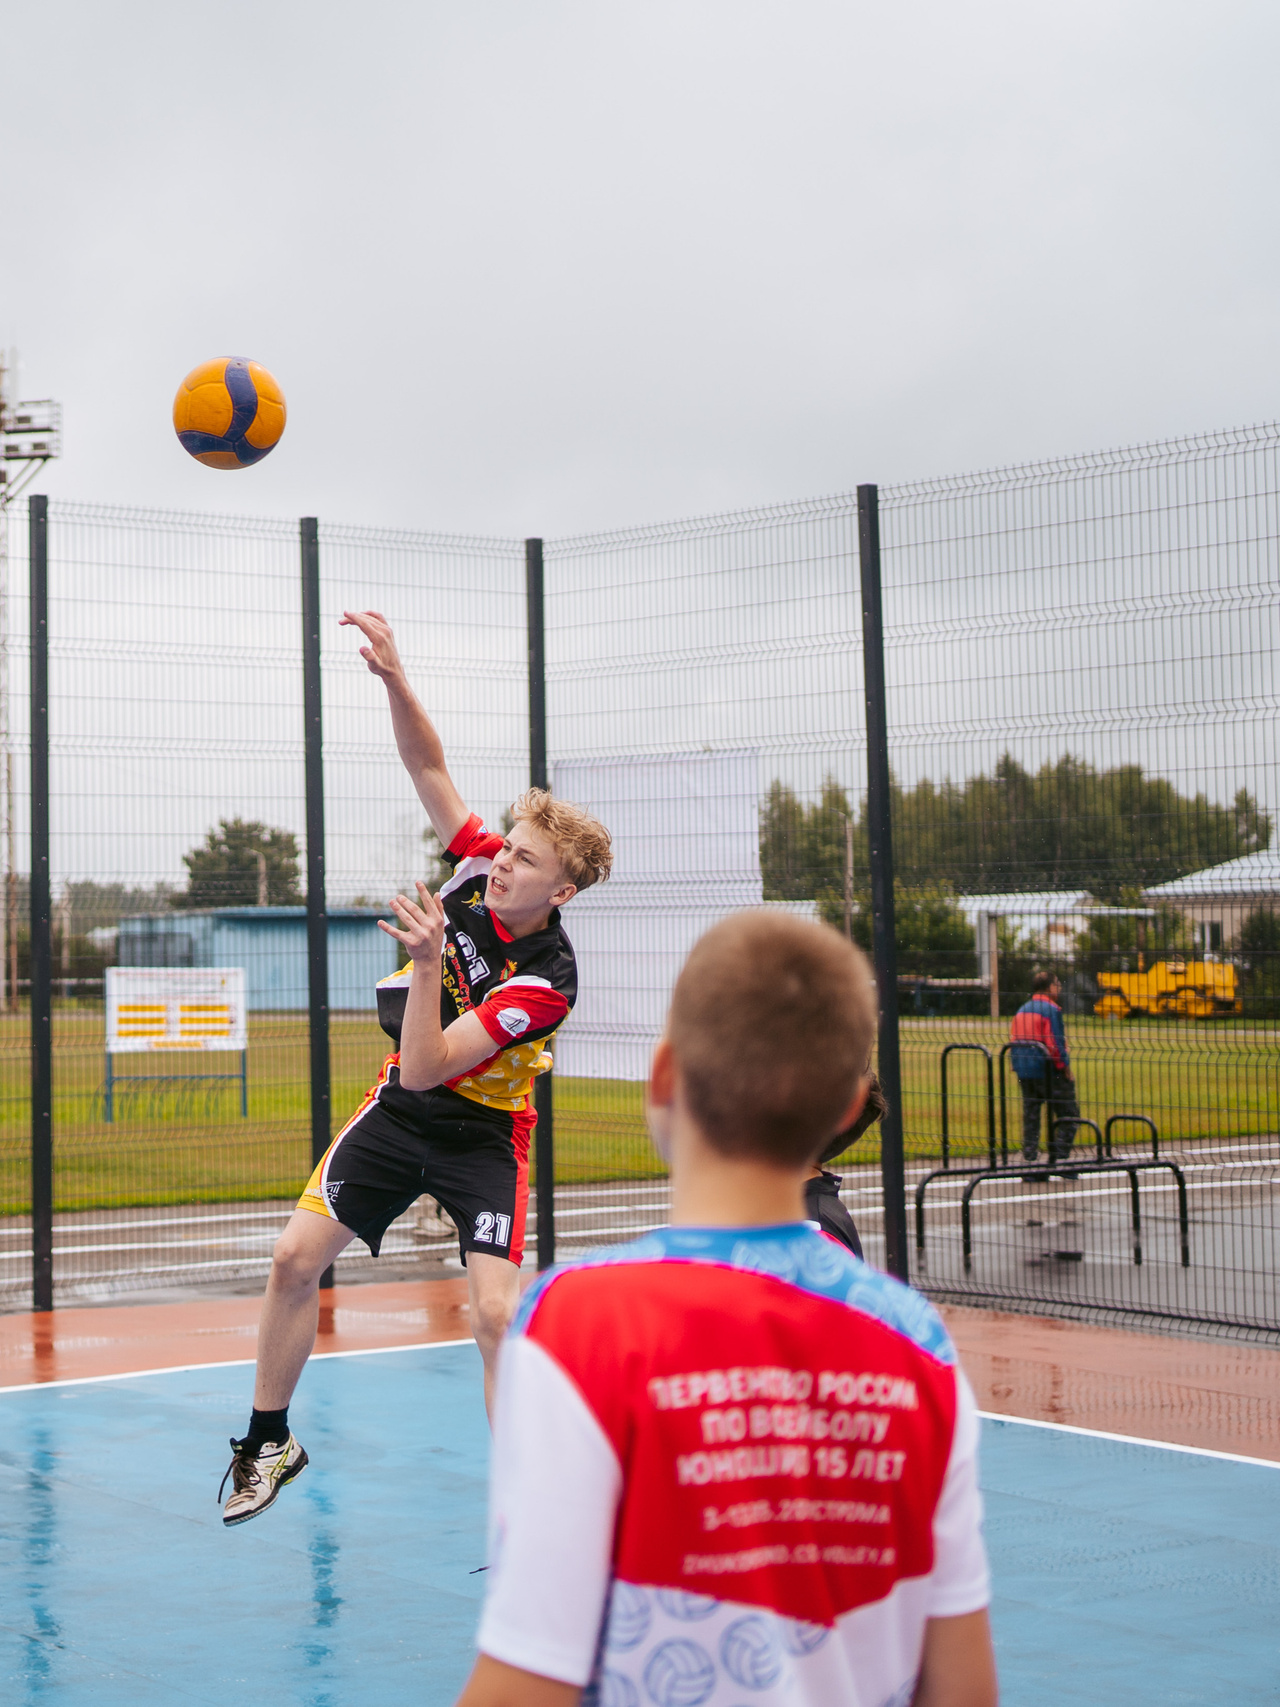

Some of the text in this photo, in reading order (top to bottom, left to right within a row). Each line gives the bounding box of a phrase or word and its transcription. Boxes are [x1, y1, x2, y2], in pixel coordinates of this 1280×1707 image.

[473, 1211, 511, 1247] 21
[700, 1406, 747, 1444] ПО
[814, 1446, 848, 1478] 15
[850, 1448, 907, 1482] ЛЕТ
